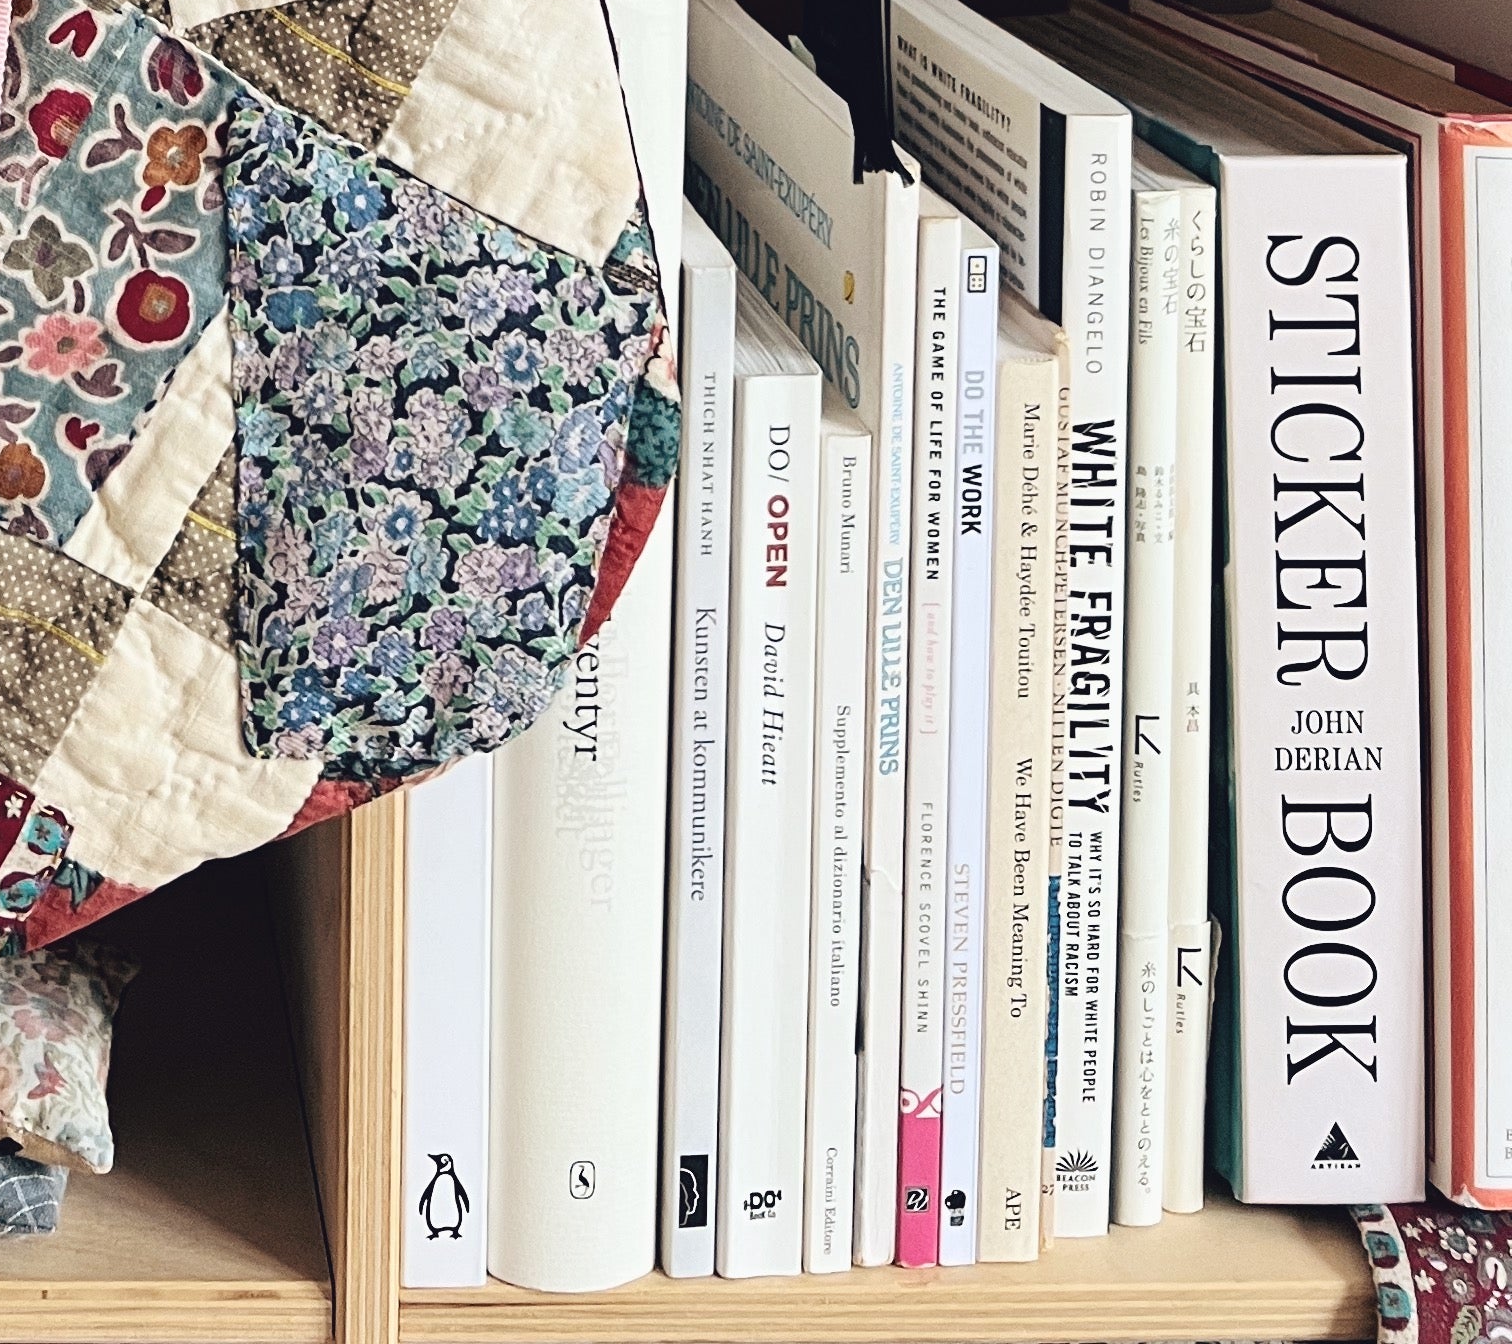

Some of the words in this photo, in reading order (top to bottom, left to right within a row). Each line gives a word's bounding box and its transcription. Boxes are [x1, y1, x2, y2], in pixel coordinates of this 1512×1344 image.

[1089, 153, 1108, 231] ROBIN
[1140, 217, 1154, 241] Les
[1136, 246, 1154, 291] Bijoux
[1162, 218, 1180, 315] 糸の宝石
[1184, 210, 1207, 353] くらしの宝石
[933, 287, 947, 321] THE
[1085, 245, 1106, 375] DIANGELO
[1139, 296, 1148, 314] en
[931, 331, 945, 382] GAME
[1138, 319, 1152, 345] Fils
[703, 372, 717, 434] THICH
[891, 362, 905, 421] ANTOINE
[931, 391, 944, 414] OF
[964, 370, 985, 400] DO
[767, 425, 791, 483] DO/
[890, 425, 903, 444] DE
[929, 421, 943, 460] LIFE
[963, 409, 984, 454] THE
[1023, 403, 1040, 460] Marie
[702, 440, 716, 495] NHAT
[842, 455, 856, 509] Bruno
[928, 470, 942, 504] FOR
[1267, 235, 1368, 686] STICKER
[961, 464, 983, 536] WORK
[1021, 466, 1040, 517] Déhé
[1070, 419, 1117, 567] WHITE
[700, 502, 714, 557] HANH
[766, 494, 789, 589] OPEN
[840, 513, 856, 574] Munari
[926, 513, 941, 581] WOMEN
[1021, 522, 1038, 538] &
[883, 558, 905, 615] DEN
[1015, 545, 1038, 618] Haydée
[694, 607, 718, 703] Kunsten
[763, 621, 788, 700] David
[1017, 624, 1035, 700] Touitou
[694, 711, 709, 731] at
[1067, 591, 1113, 813] FRAGILITY
[1291, 709, 1364, 735] JOHN
[761, 705, 785, 787] Hieatt
[833, 704, 852, 819] Supplemento
[878, 696, 901, 777] PRINS
[1275, 746, 1383, 772] DERIAN
[1016, 757, 1034, 786] We
[690, 739, 716, 902] kommunikere
[834, 824, 849, 841] al
[920, 802, 932, 892] FLORENCE
[1014, 796, 1032, 844] Have
[1068, 832, 1082, 848] TO
[1089, 832, 1103, 862] WHY
[831, 847, 848, 936] dizionario
[1013, 849, 1031, 895] Been
[1067, 855, 1082, 889] TALK
[1088, 867, 1102, 894] IT'S
[952, 864, 970, 952] STEVEN
[1066, 894, 1081, 937] ABOUT
[1088, 900, 1101, 917] SO
[918, 902, 931, 969] SCOVEL
[1007, 902, 1031, 988] Meaning
[1087, 924, 1100, 960] HARD
[1281, 794, 1377, 1087] BOOK
[830, 942, 845, 1008] italiano
[1065, 943, 1080, 997] RACISM
[1086, 967, 1098, 993] FOR
[917, 978, 929, 1034] SHINN
[948, 960, 969, 1095] PRESSFIELD
[1010, 995, 1028, 1019] To
[1084, 1000, 1098, 1043] WHITE
[1082, 1050, 1097, 1102] PEOPLE
[825, 1147, 839, 1203] Corraini
[823, 1206, 837, 1256] Editore
[1004, 1187, 1023, 1232] APE
